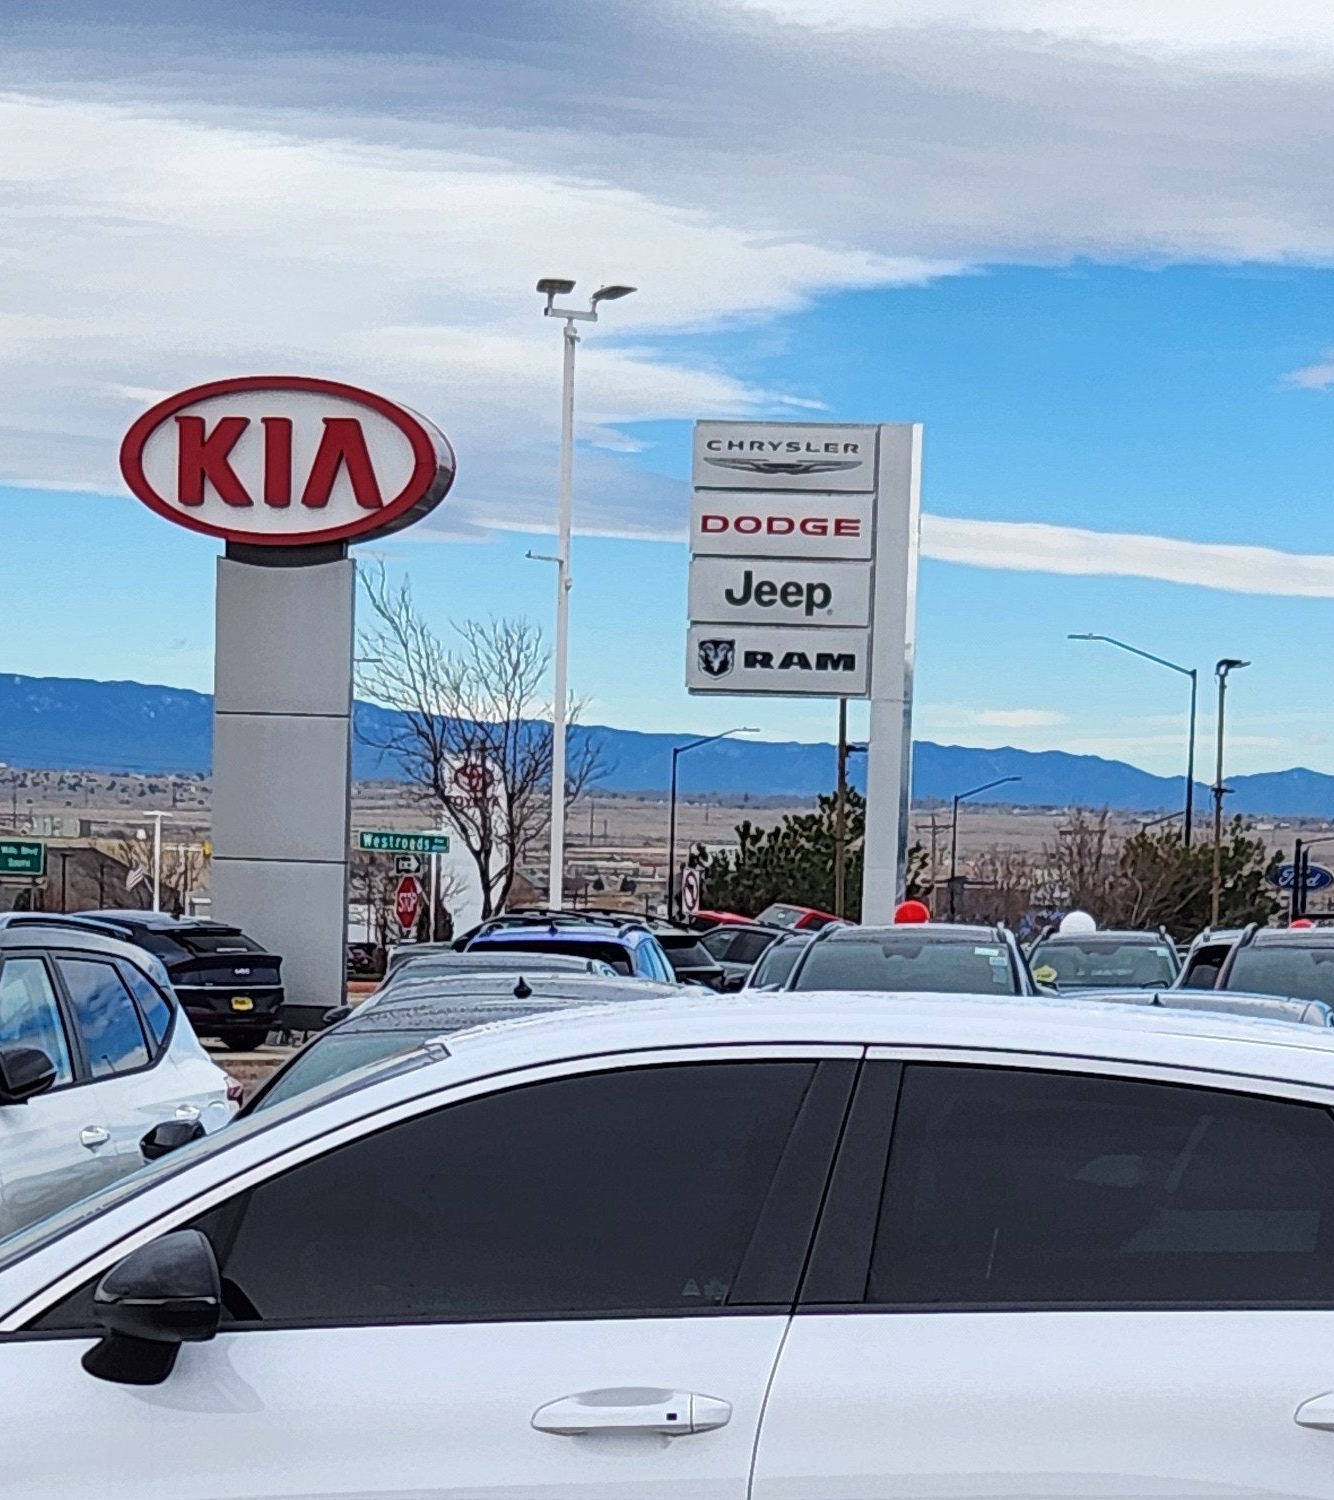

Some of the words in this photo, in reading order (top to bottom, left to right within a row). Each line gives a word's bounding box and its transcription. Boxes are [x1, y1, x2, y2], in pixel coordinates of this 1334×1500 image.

[706, 439, 860, 454] CHRYSLER
[175, 415, 384, 509] KIA
[700, 514, 861, 537] DODGE
[724, 570, 832, 616] Jeep
[743, 651, 856, 672] RAM
[363, 833, 430, 850] Westroads
[1278, 866, 1322, 887] Fd
[398, 892, 419, 913] STOP
